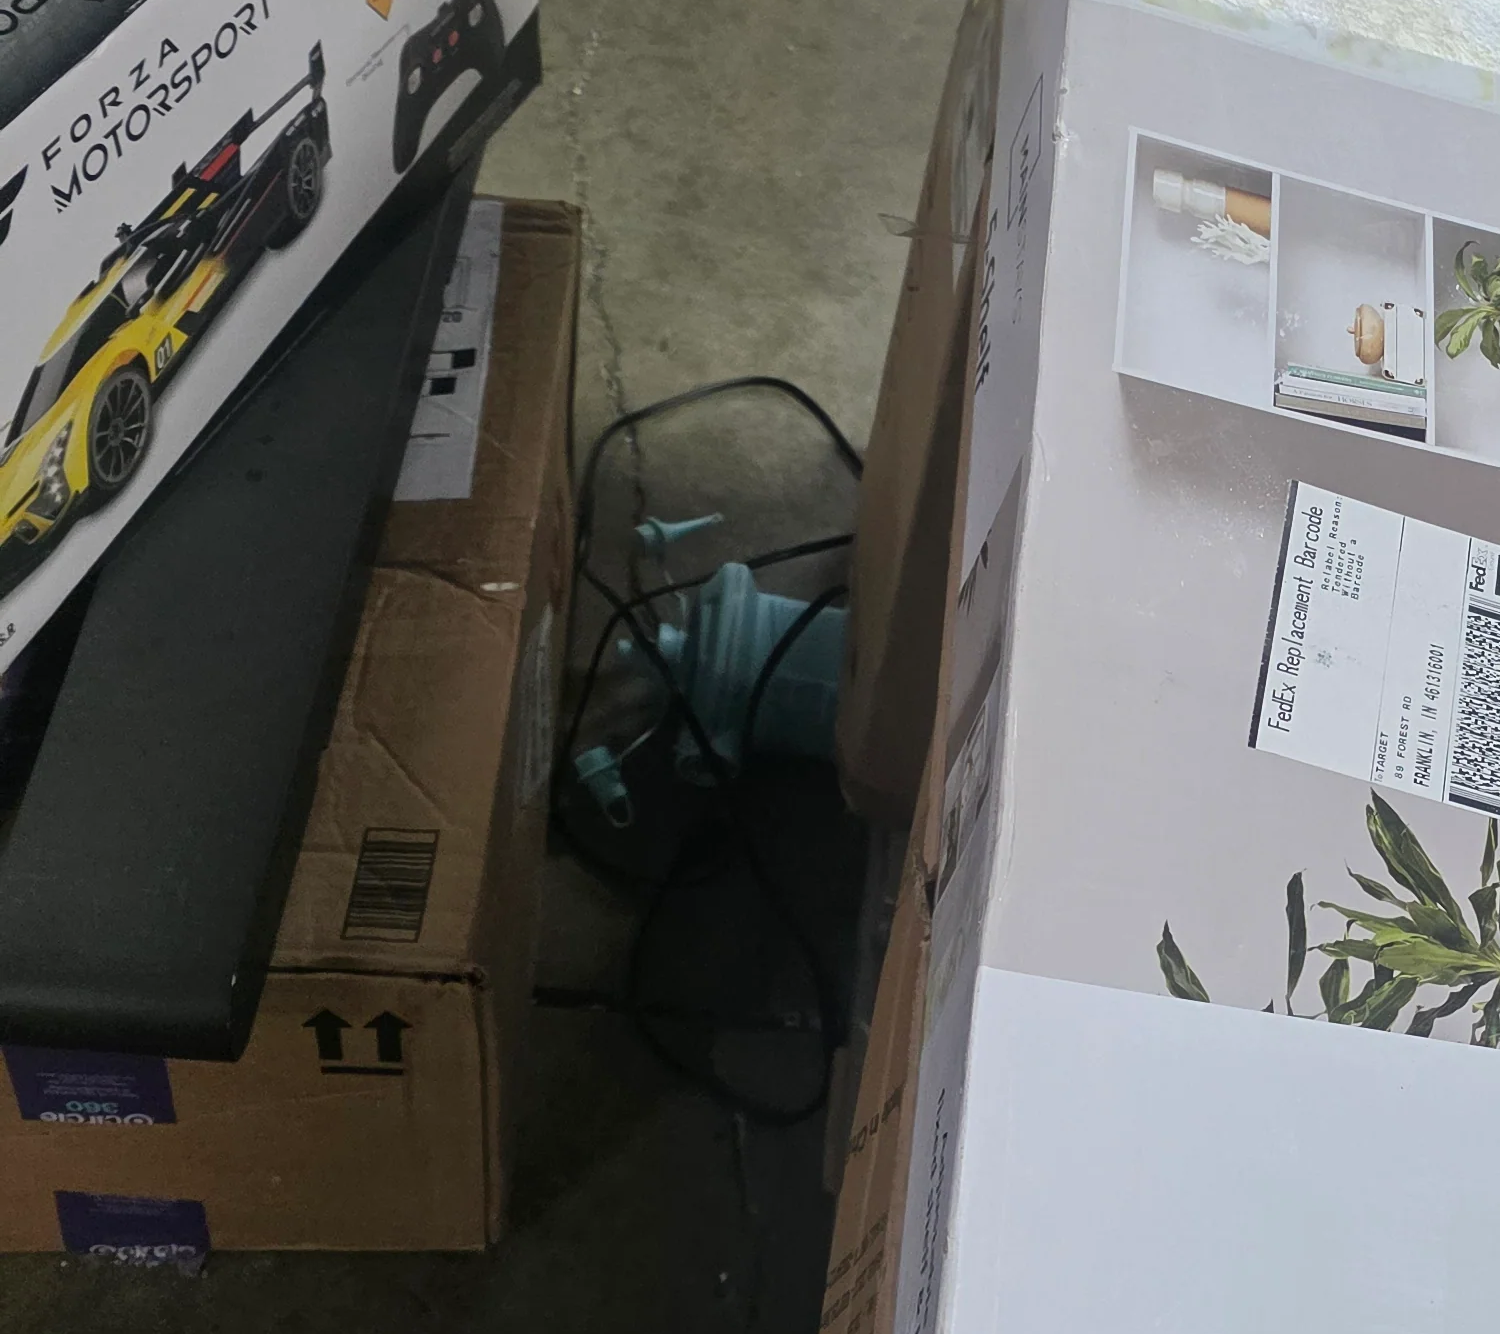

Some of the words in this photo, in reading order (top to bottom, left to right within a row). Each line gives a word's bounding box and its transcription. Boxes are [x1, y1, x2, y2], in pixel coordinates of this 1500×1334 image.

[41, 38, 181, 171] FORZA
[1294, 506, 1323, 569] Barcode
[1328, 496, 1343, 540] Reason:
[1321, 545, 1336, 592] Relabel
[1332, 541, 1347, 594] Tendered
[1341, 552, 1357, 598] Without
[1350, 554, 1365, 601] Barcode
[1276, 576, 1314, 677] Replacement
[1424, 643, 1444, 701] 461316001
[1268, 683, 1297, 733] FedEx
[1402, 695, 1412, 711] RD
[1421, 704, 1437, 720] IN
[1375, 732, 1389, 774] TARGET
[1396, 716, 1410, 759] FOREST
[1413, 729, 1437, 788] FRANKLIN,
[1394, 765, 1405, 779] 89
